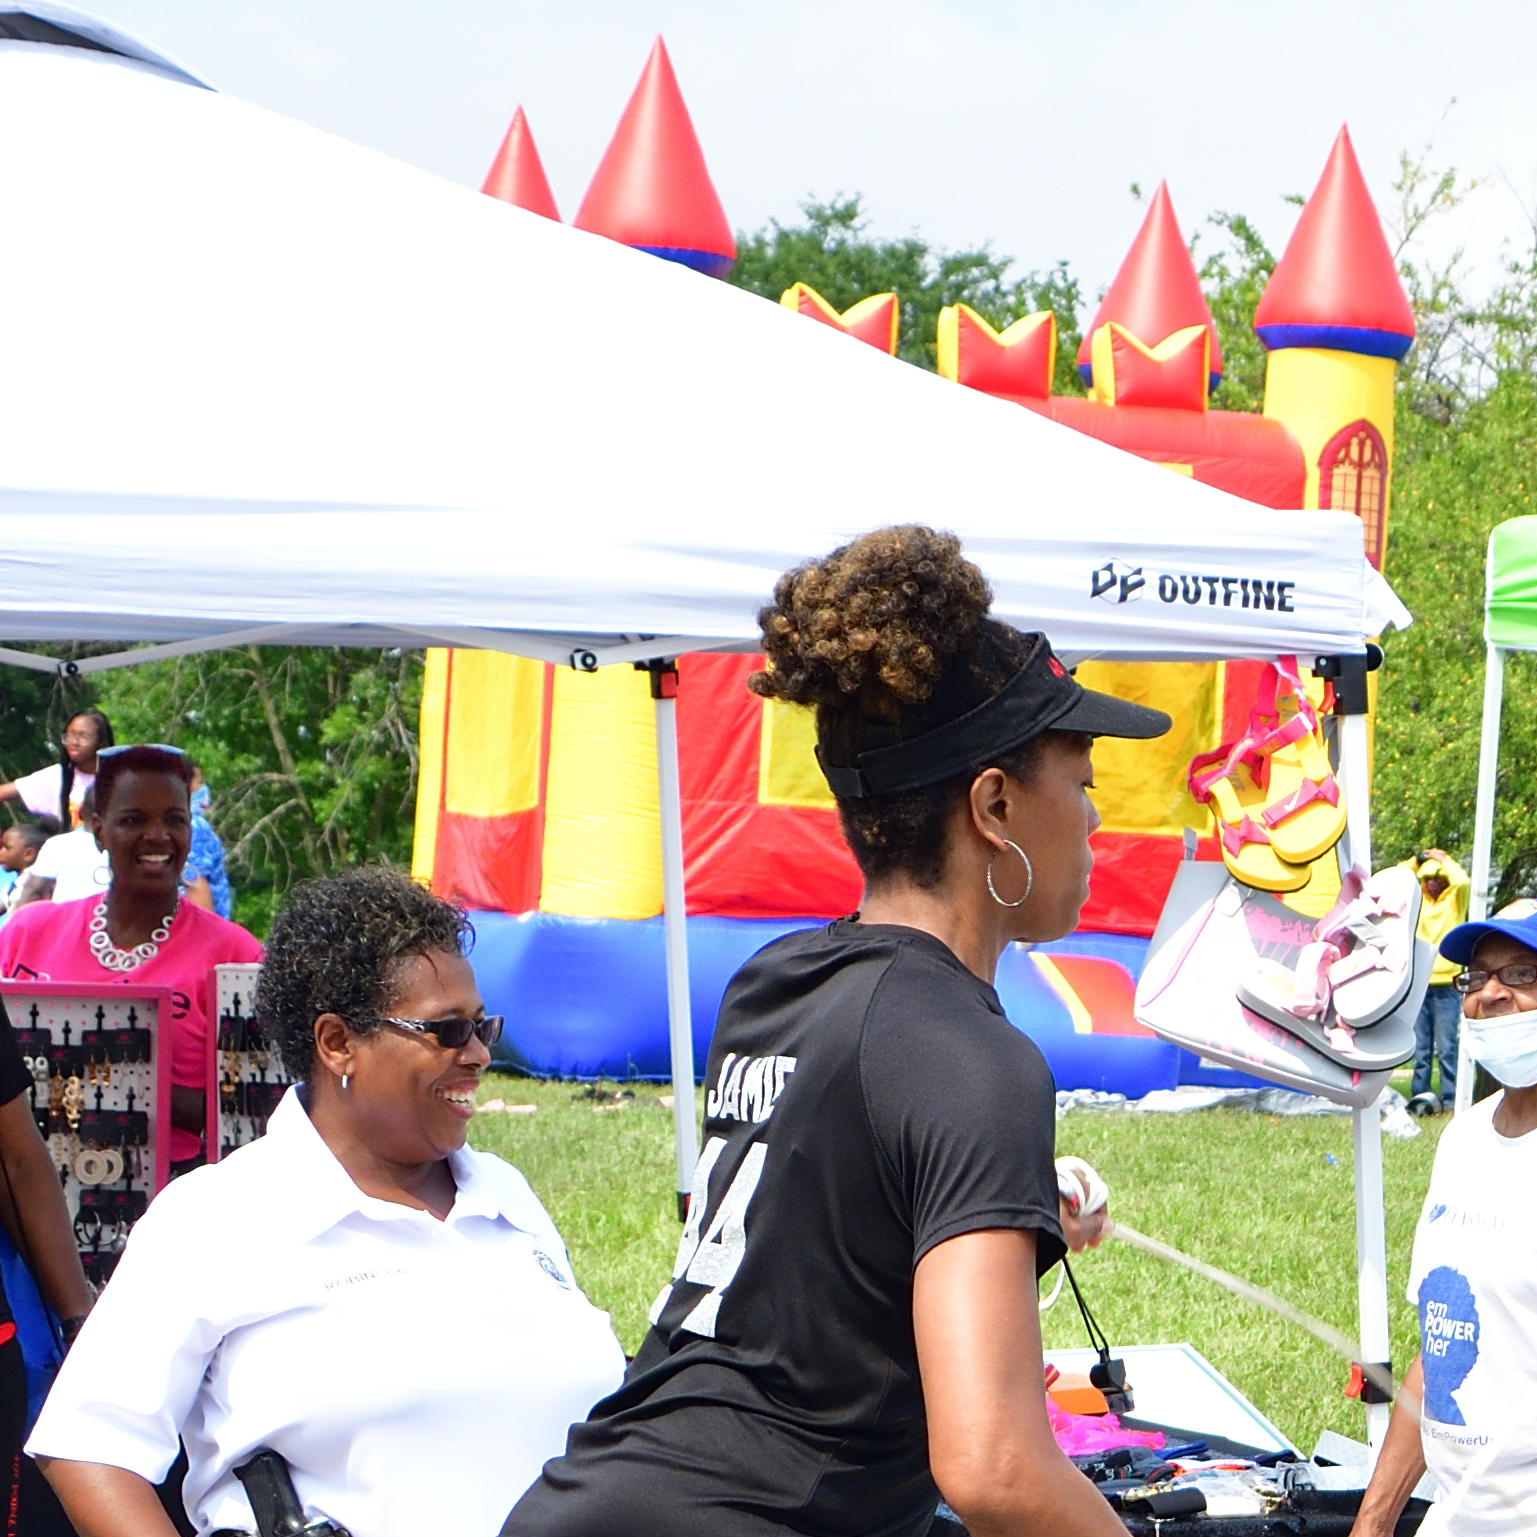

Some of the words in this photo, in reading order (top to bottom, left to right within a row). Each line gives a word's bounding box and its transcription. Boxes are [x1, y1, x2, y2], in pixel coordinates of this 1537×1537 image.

[1158, 573, 1296, 613] OUTFINE
[1426, 1300, 1448, 1317] em
[1425, 1313, 1476, 1342] POWER
[1426, 1329, 1451, 1357] her
